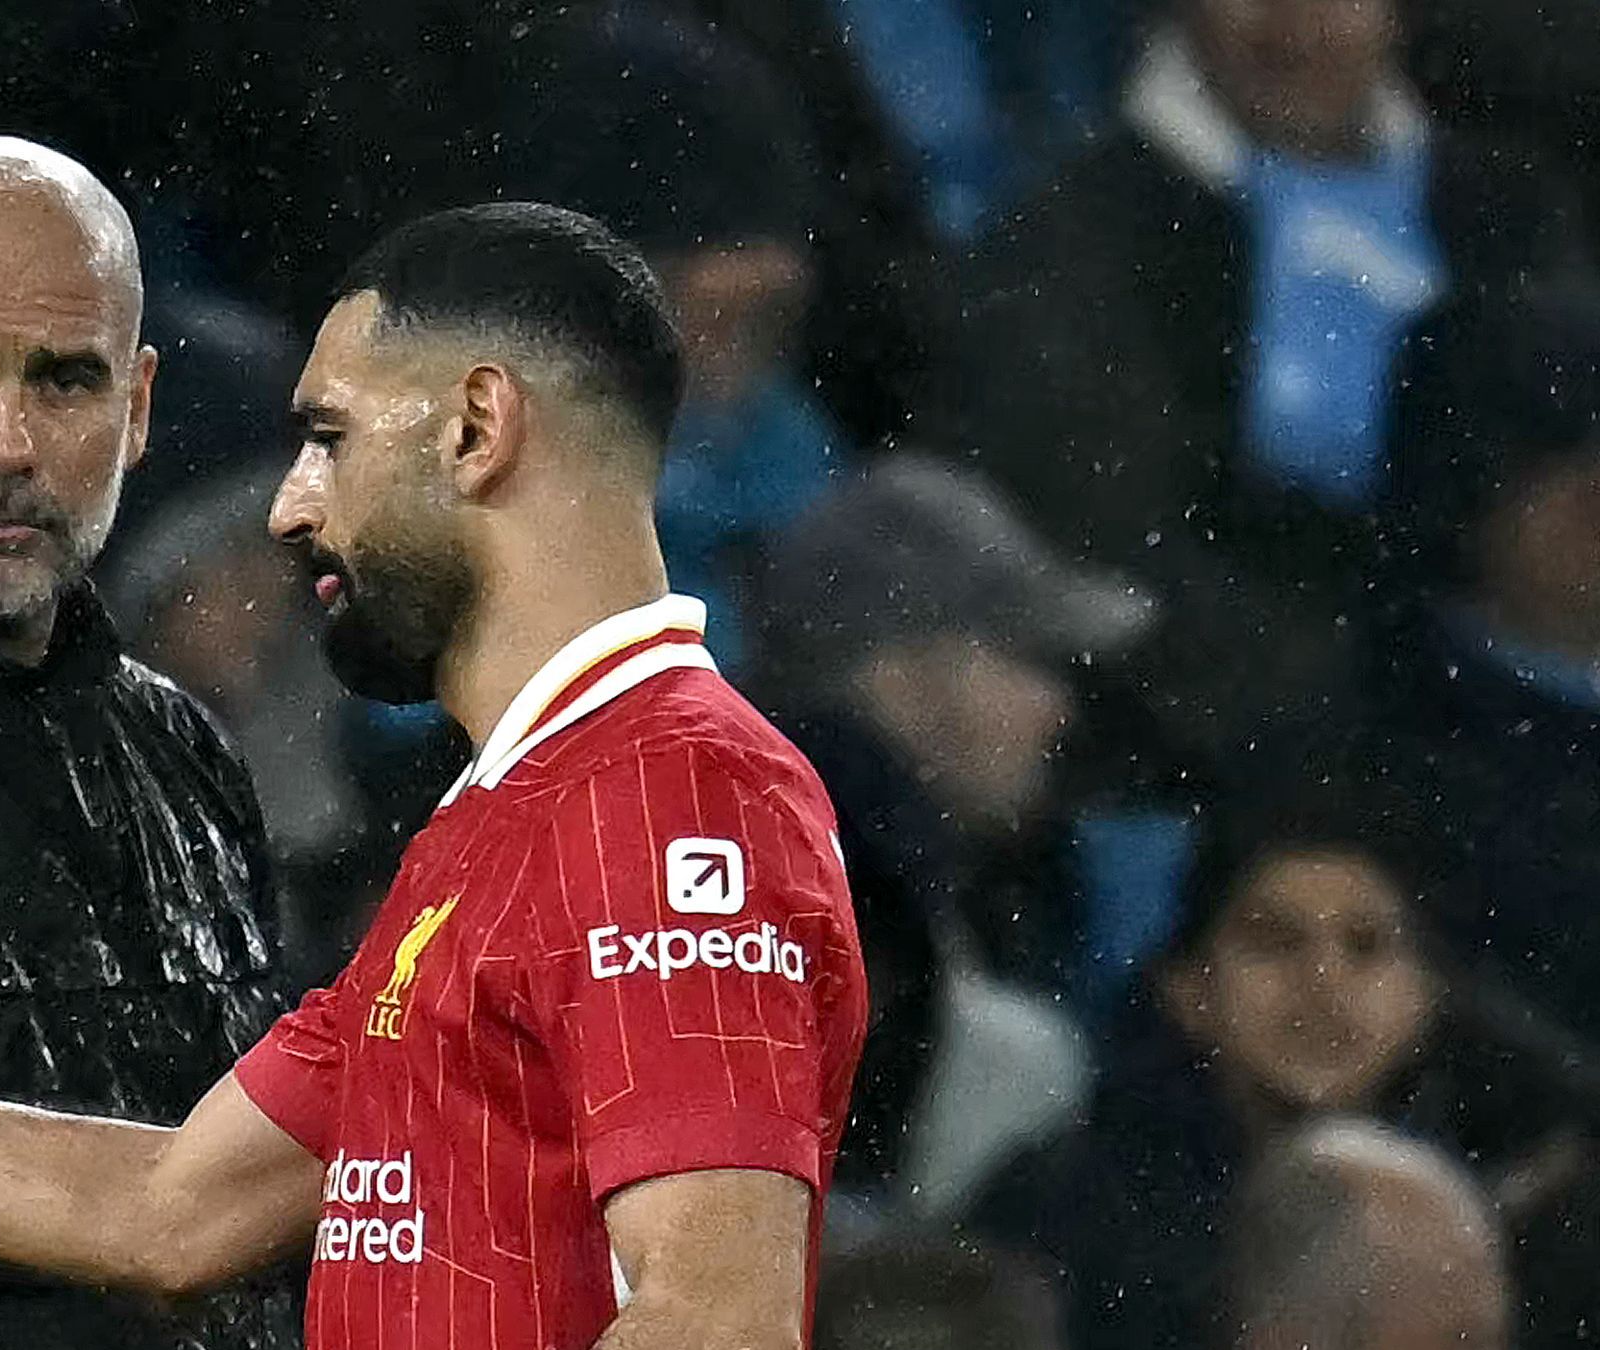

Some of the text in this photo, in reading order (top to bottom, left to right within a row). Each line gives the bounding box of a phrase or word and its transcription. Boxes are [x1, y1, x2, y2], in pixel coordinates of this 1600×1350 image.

[588, 921, 805, 983] Expedia
[323, 1148, 412, 1204] dard
[313, 1209, 425, 1264] tered
